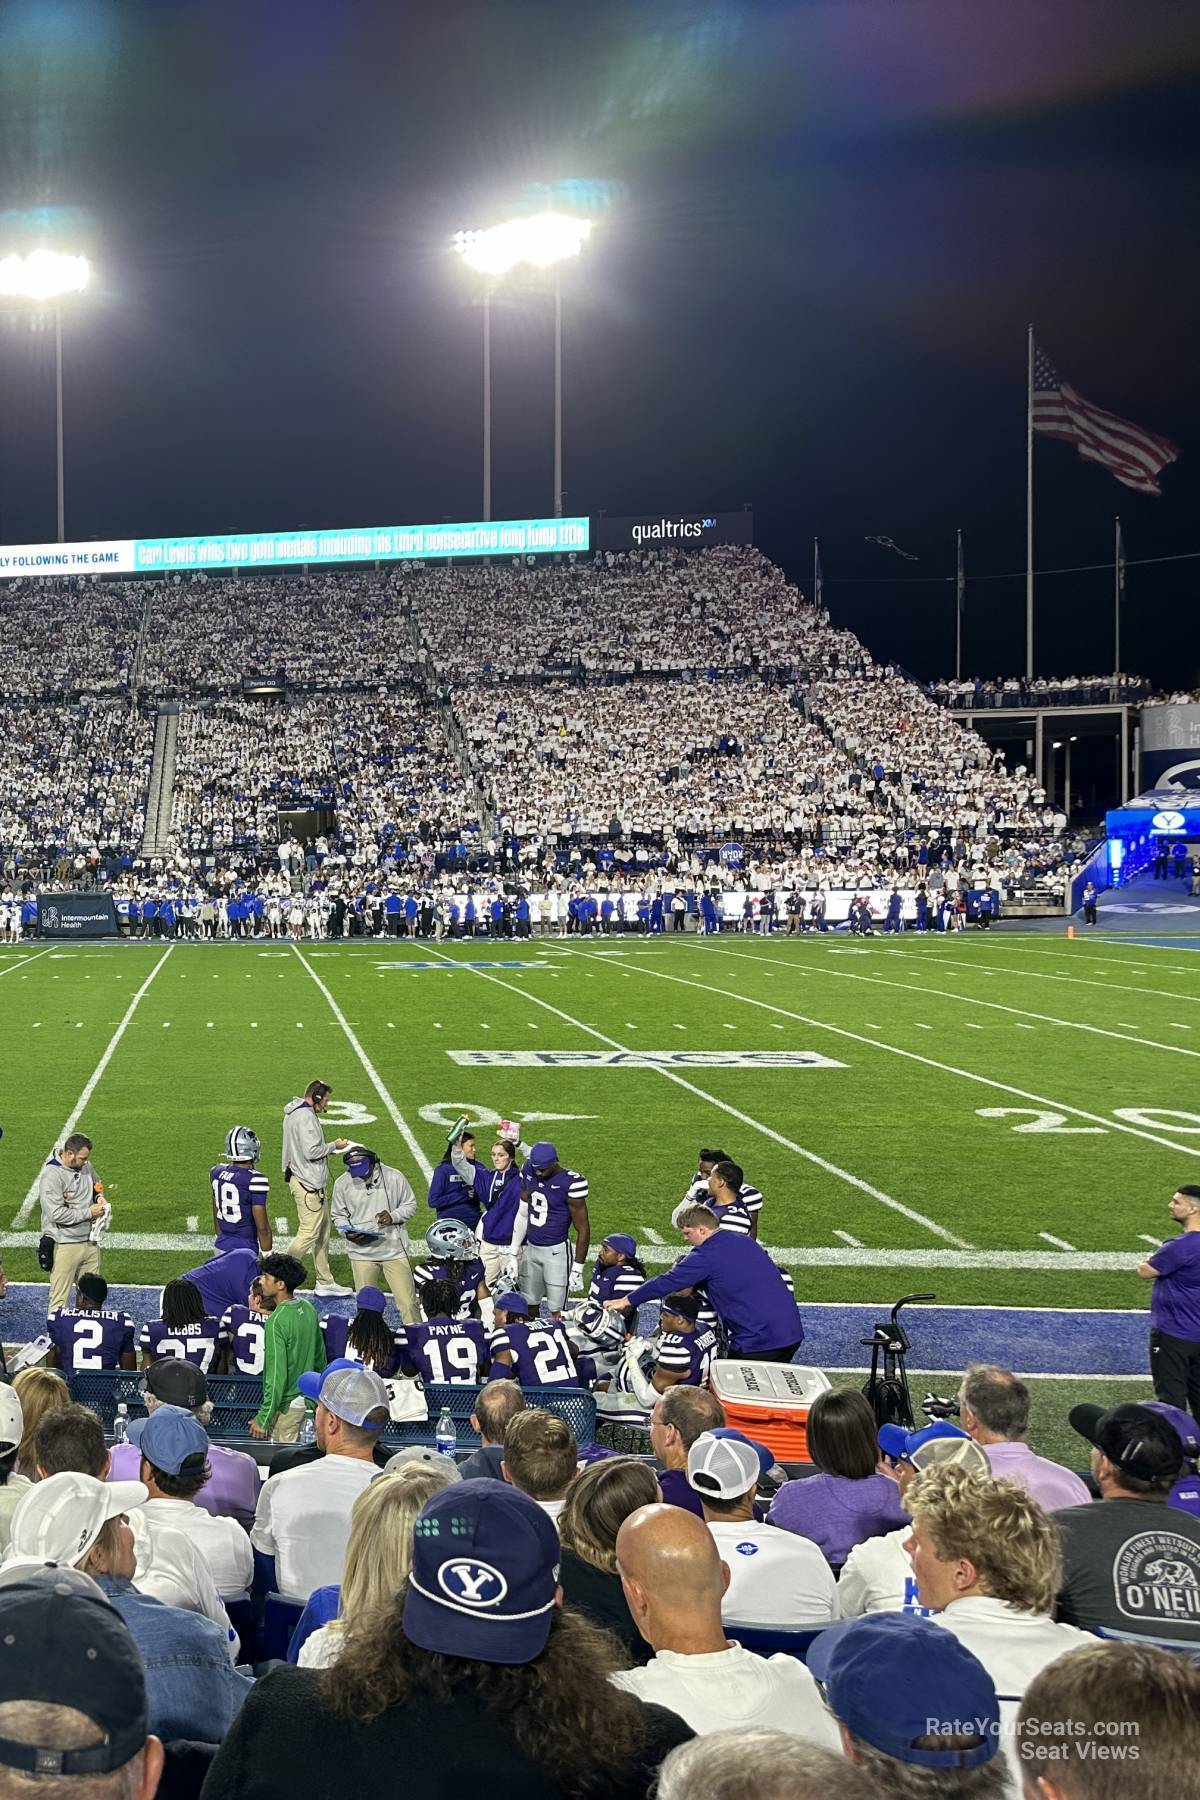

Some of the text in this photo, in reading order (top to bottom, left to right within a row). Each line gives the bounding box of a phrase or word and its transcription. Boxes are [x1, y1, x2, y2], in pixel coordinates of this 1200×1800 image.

[632, 518, 701, 545] qualtrics
[164, 543, 196, 564] Lewis
[227, 542, 248, 561] two
[250, 540, 275, 562] gold
[277, 538, 318, 559] medals
[320, 535, 371, 557] including
[374, 533, 392, 554] his
[426, 529, 498, 551] consecutive
[500, 527, 526, 550] long
[527, 525, 558, 551] jump
[12, 555, 68, 567] FOLLOWING
[70, 554, 90, 565] THE
[91, 552, 120, 564] GAME
[721, 850, 743, 860] ROAR
[61, 913, 109, 922] Intermountain
[61, 921, 82, 929] Health
[535, 1052, 817, 1065] PACS
[211, 1179, 242, 1224] 18
[529, 1190, 549, 1228] 9
[60, 1308, 119, 1322] McCALISTER
[428, 1323, 466, 1336] PAYNE
[72, 1319, 104, 1370] 2
[422, 1337, 478, 1385] 19
[526, 1328, 578, 1384] 21
[1129, 1536, 1157, 1554] FINEST
[1157, 1536, 1197, 1554] WETSUIT
[449, 1564, 495, 1600] Y
